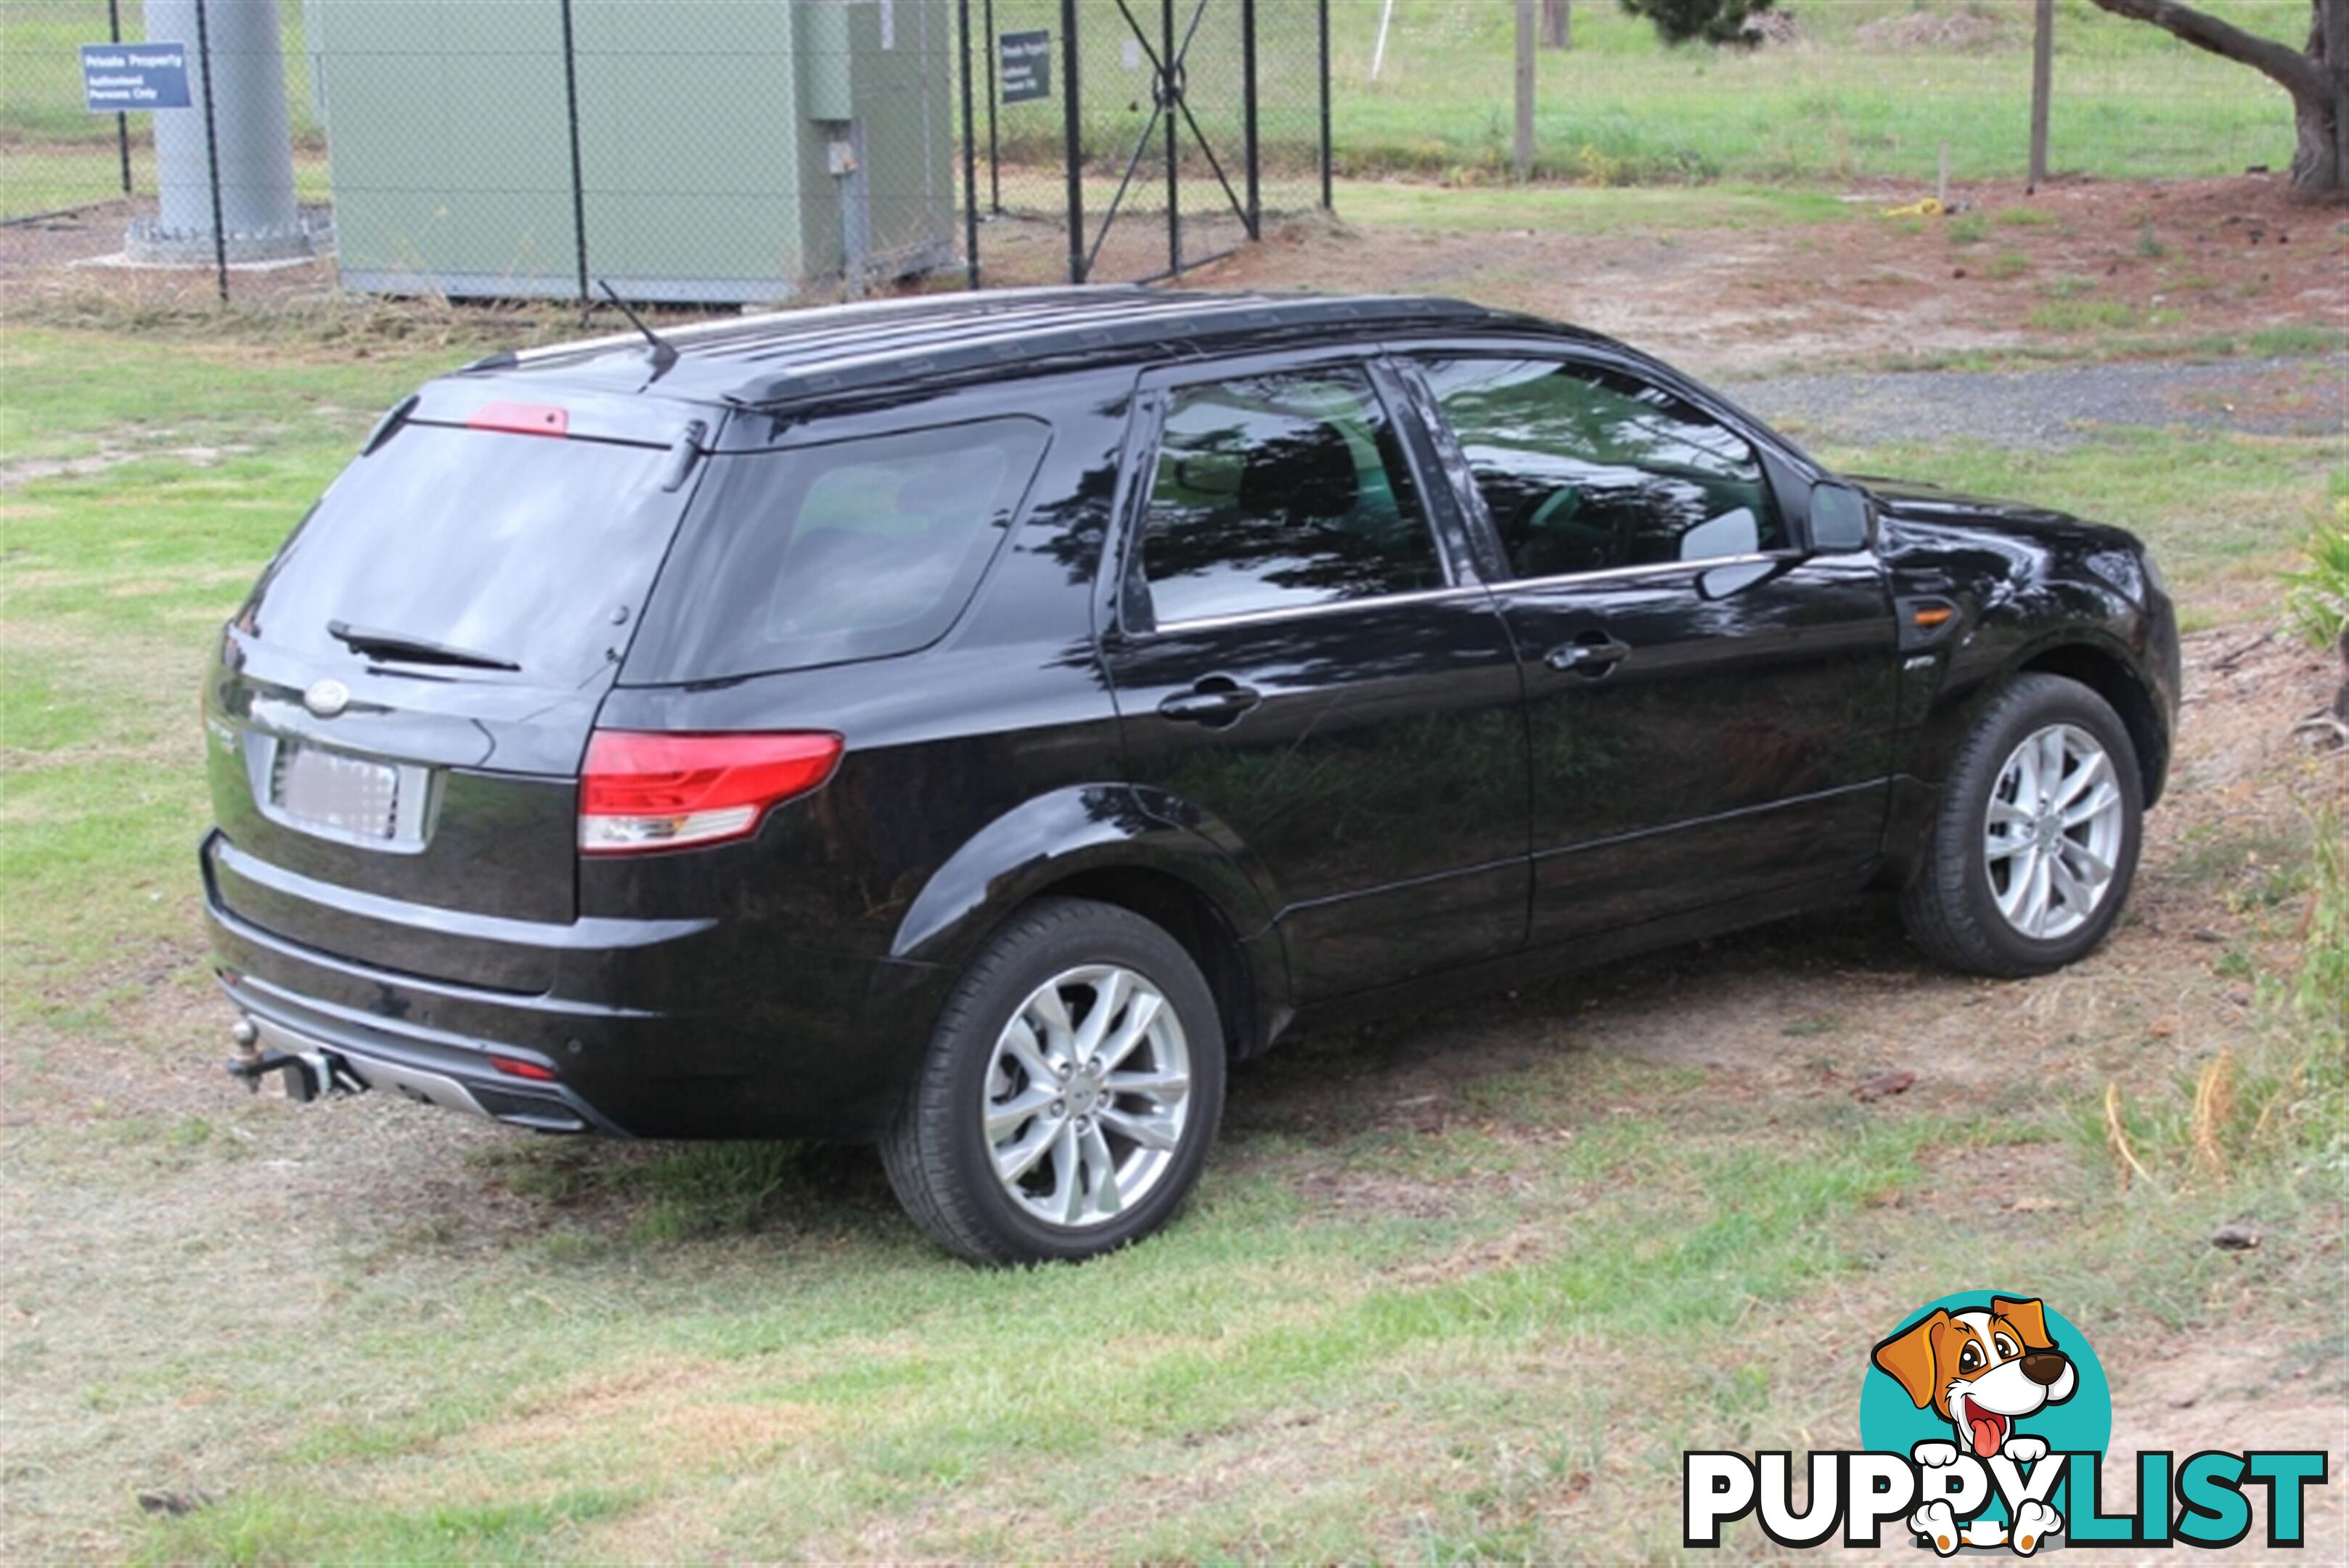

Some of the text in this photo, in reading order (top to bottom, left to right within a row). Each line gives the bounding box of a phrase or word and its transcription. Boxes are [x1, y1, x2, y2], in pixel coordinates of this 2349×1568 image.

[86, 54, 181, 68] Private Property
[133, 88, 158, 99] Only
